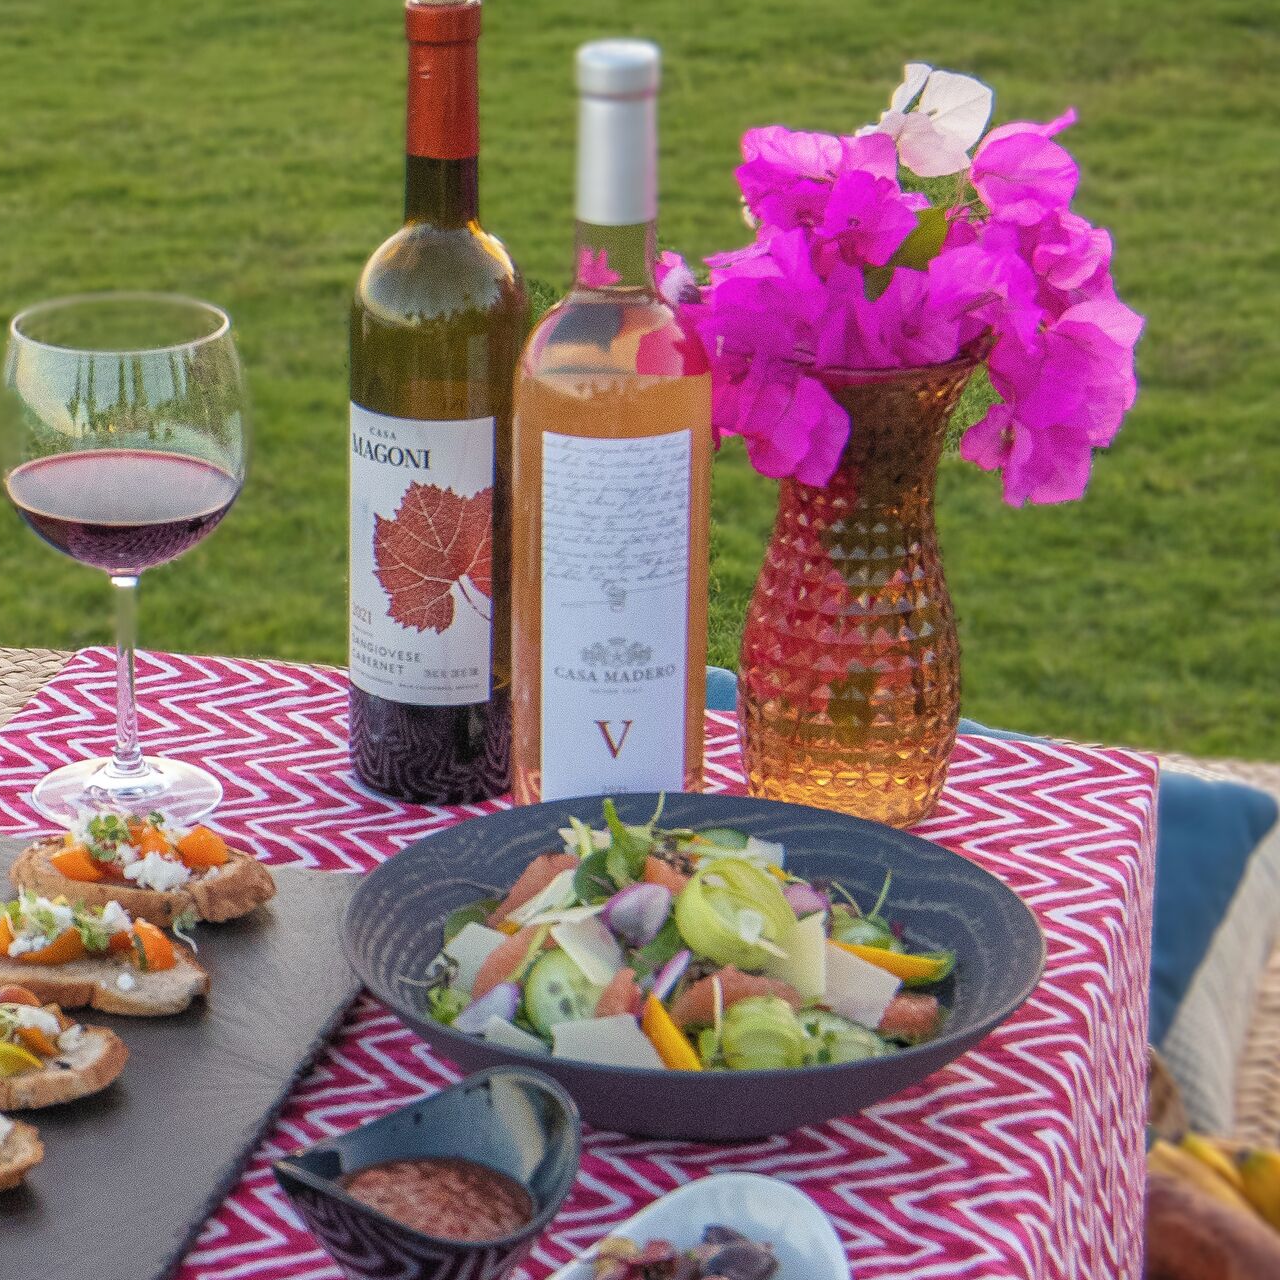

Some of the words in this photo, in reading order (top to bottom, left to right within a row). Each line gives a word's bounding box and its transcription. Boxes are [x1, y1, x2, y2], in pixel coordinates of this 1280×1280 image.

[369, 426, 396, 441] CASA
[352, 432, 430, 470] MAGONI
[553, 665, 598, 682] CASA
[604, 663, 676, 683] MADERO
[593, 720, 634, 759] V
